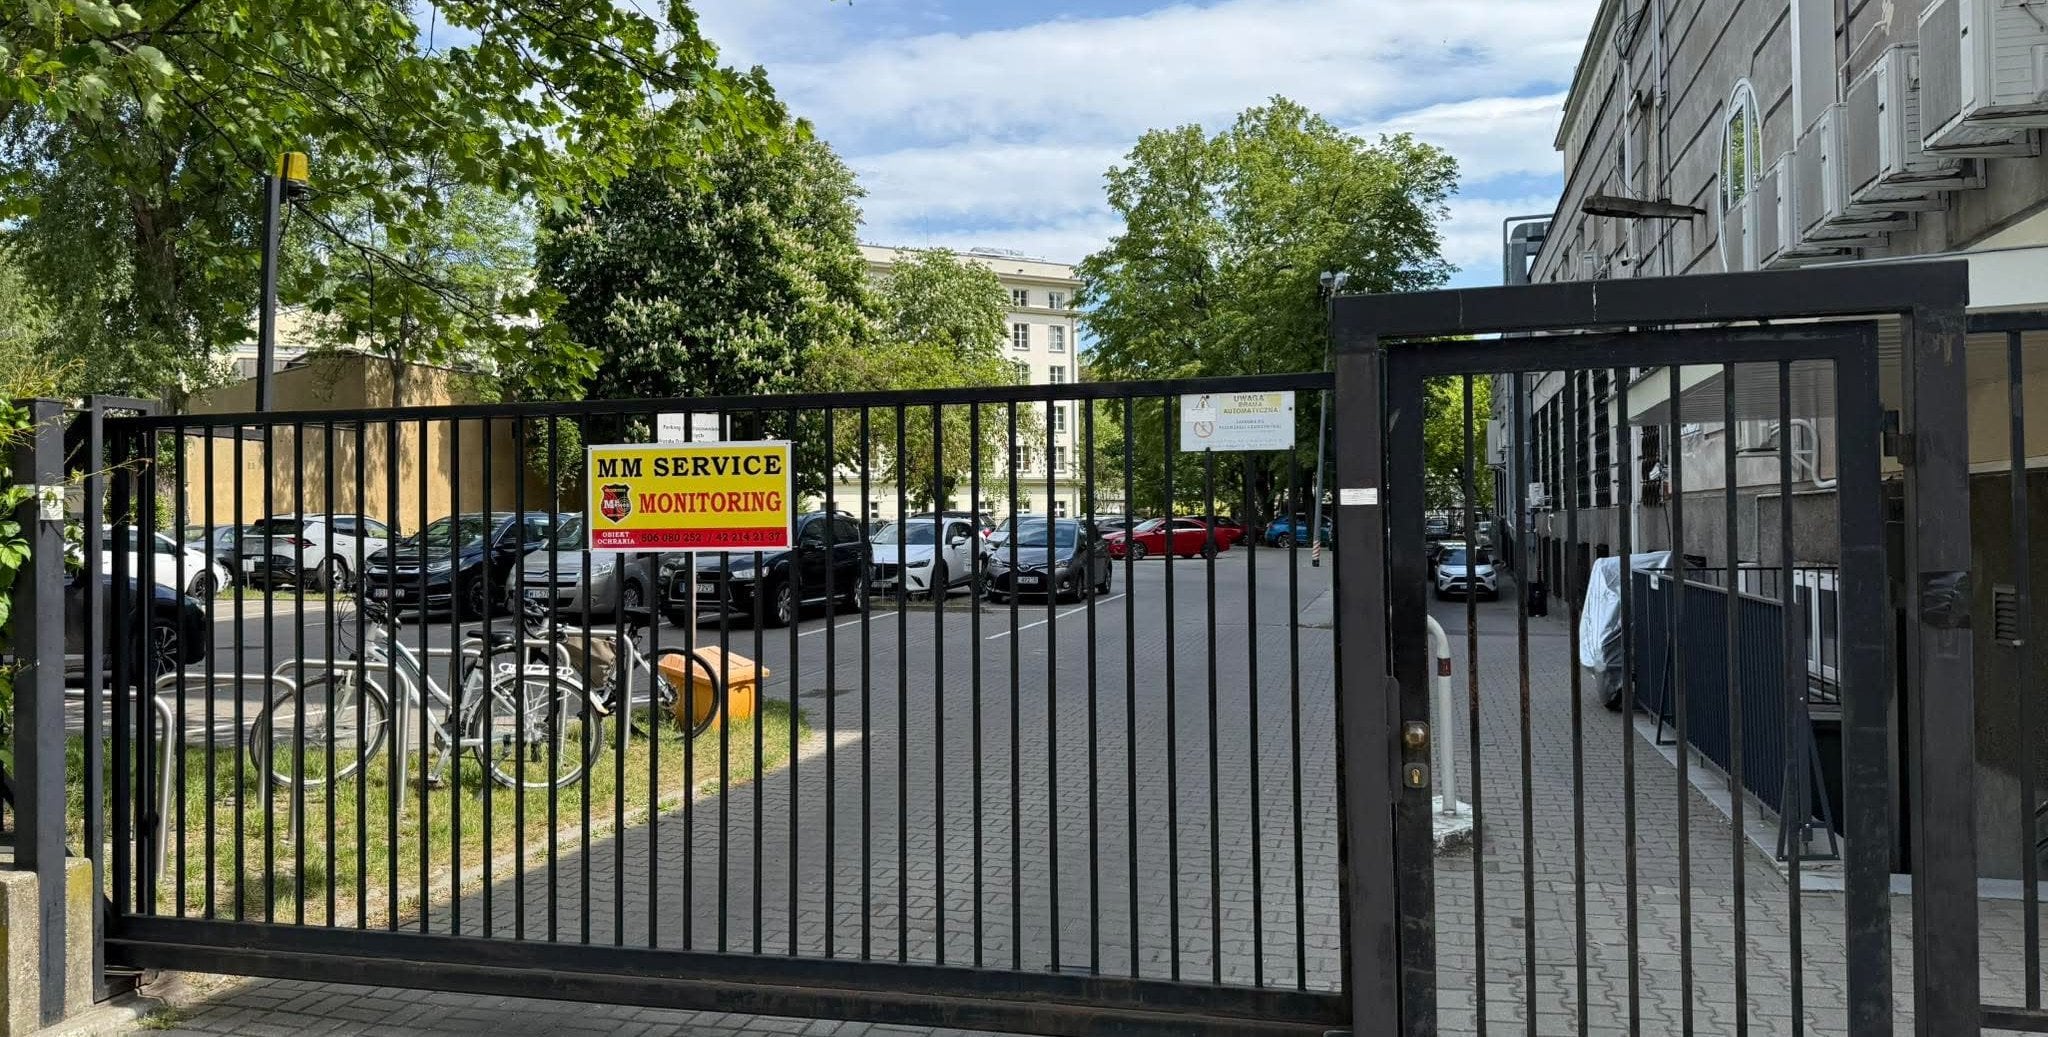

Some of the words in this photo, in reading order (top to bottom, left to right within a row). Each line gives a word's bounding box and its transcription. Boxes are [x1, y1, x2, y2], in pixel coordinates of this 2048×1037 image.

[1233, 394, 1264, 402] UWAGA
[597, 458, 642, 478] MM
[654, 455, 782, 476] SERVICE
[639, 491, 782, 514] MONITORING
[716, 533, 729, 542] 42
[732, 533, 749, 542] 214
